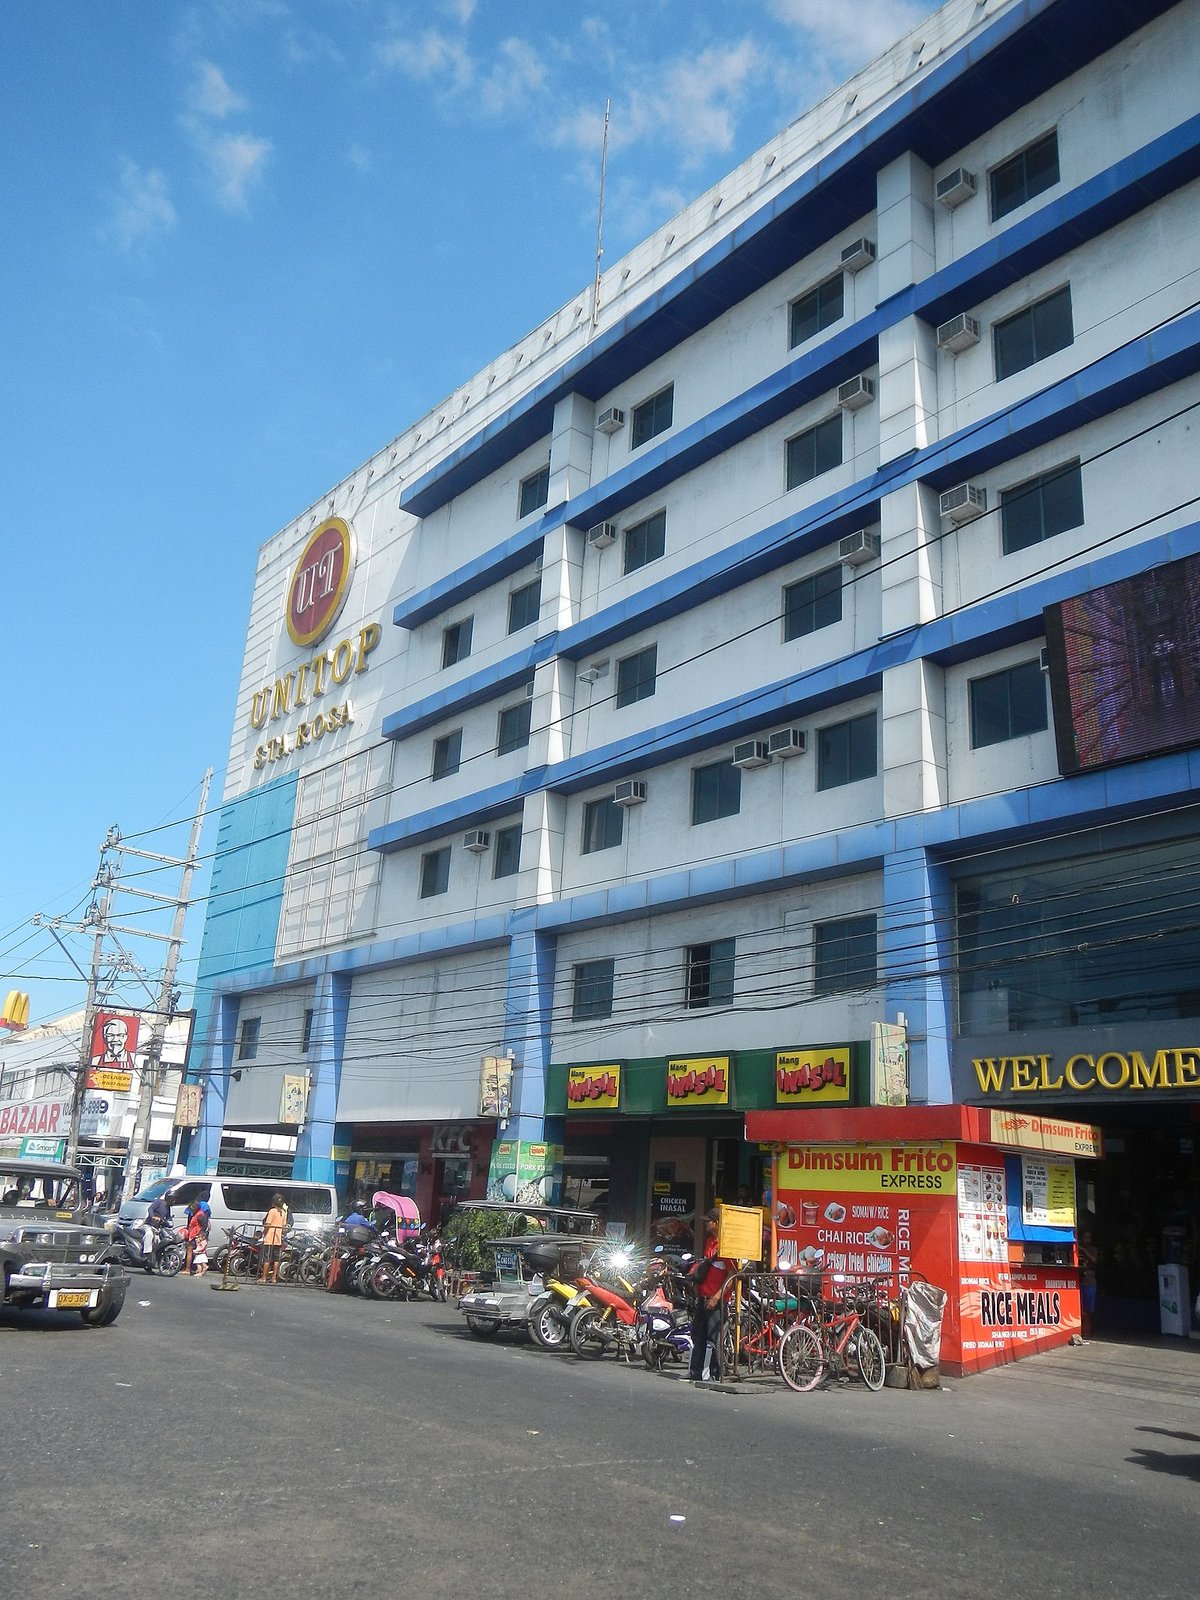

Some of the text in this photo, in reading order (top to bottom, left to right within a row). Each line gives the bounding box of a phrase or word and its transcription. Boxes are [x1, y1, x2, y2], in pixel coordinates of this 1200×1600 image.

[250, 623, 382, 730] UNITOP
[296, 699, 355, 749] ROSA
[778, 1056, 800, 1066] Mang
[971, 1047, 1200, 1092] WELCOME
[0, 1103, 61, 1134] BAZAAR
[429, 1126, 473, 1152] KFC
[1031, 1119, 1099, 1142] Dimsum Frito
[1074, 1142, 1100, 1153] EXPRESS
[788, 1148, 954, 1172] Dimsum Frito
[881, 1174, 942, 1189] EXPRESS
[660, 1197, 687, 1205] CHICKEN
[660, 1204, 686, 1213] INASAL
[817, 1229, 871, 1246] CHAI RICE
[898, 1209, 910, 1251] RICE
[848, 1252, 865, 1272] fried
[981, 1291, 1060, 1326] RICE MEALS
